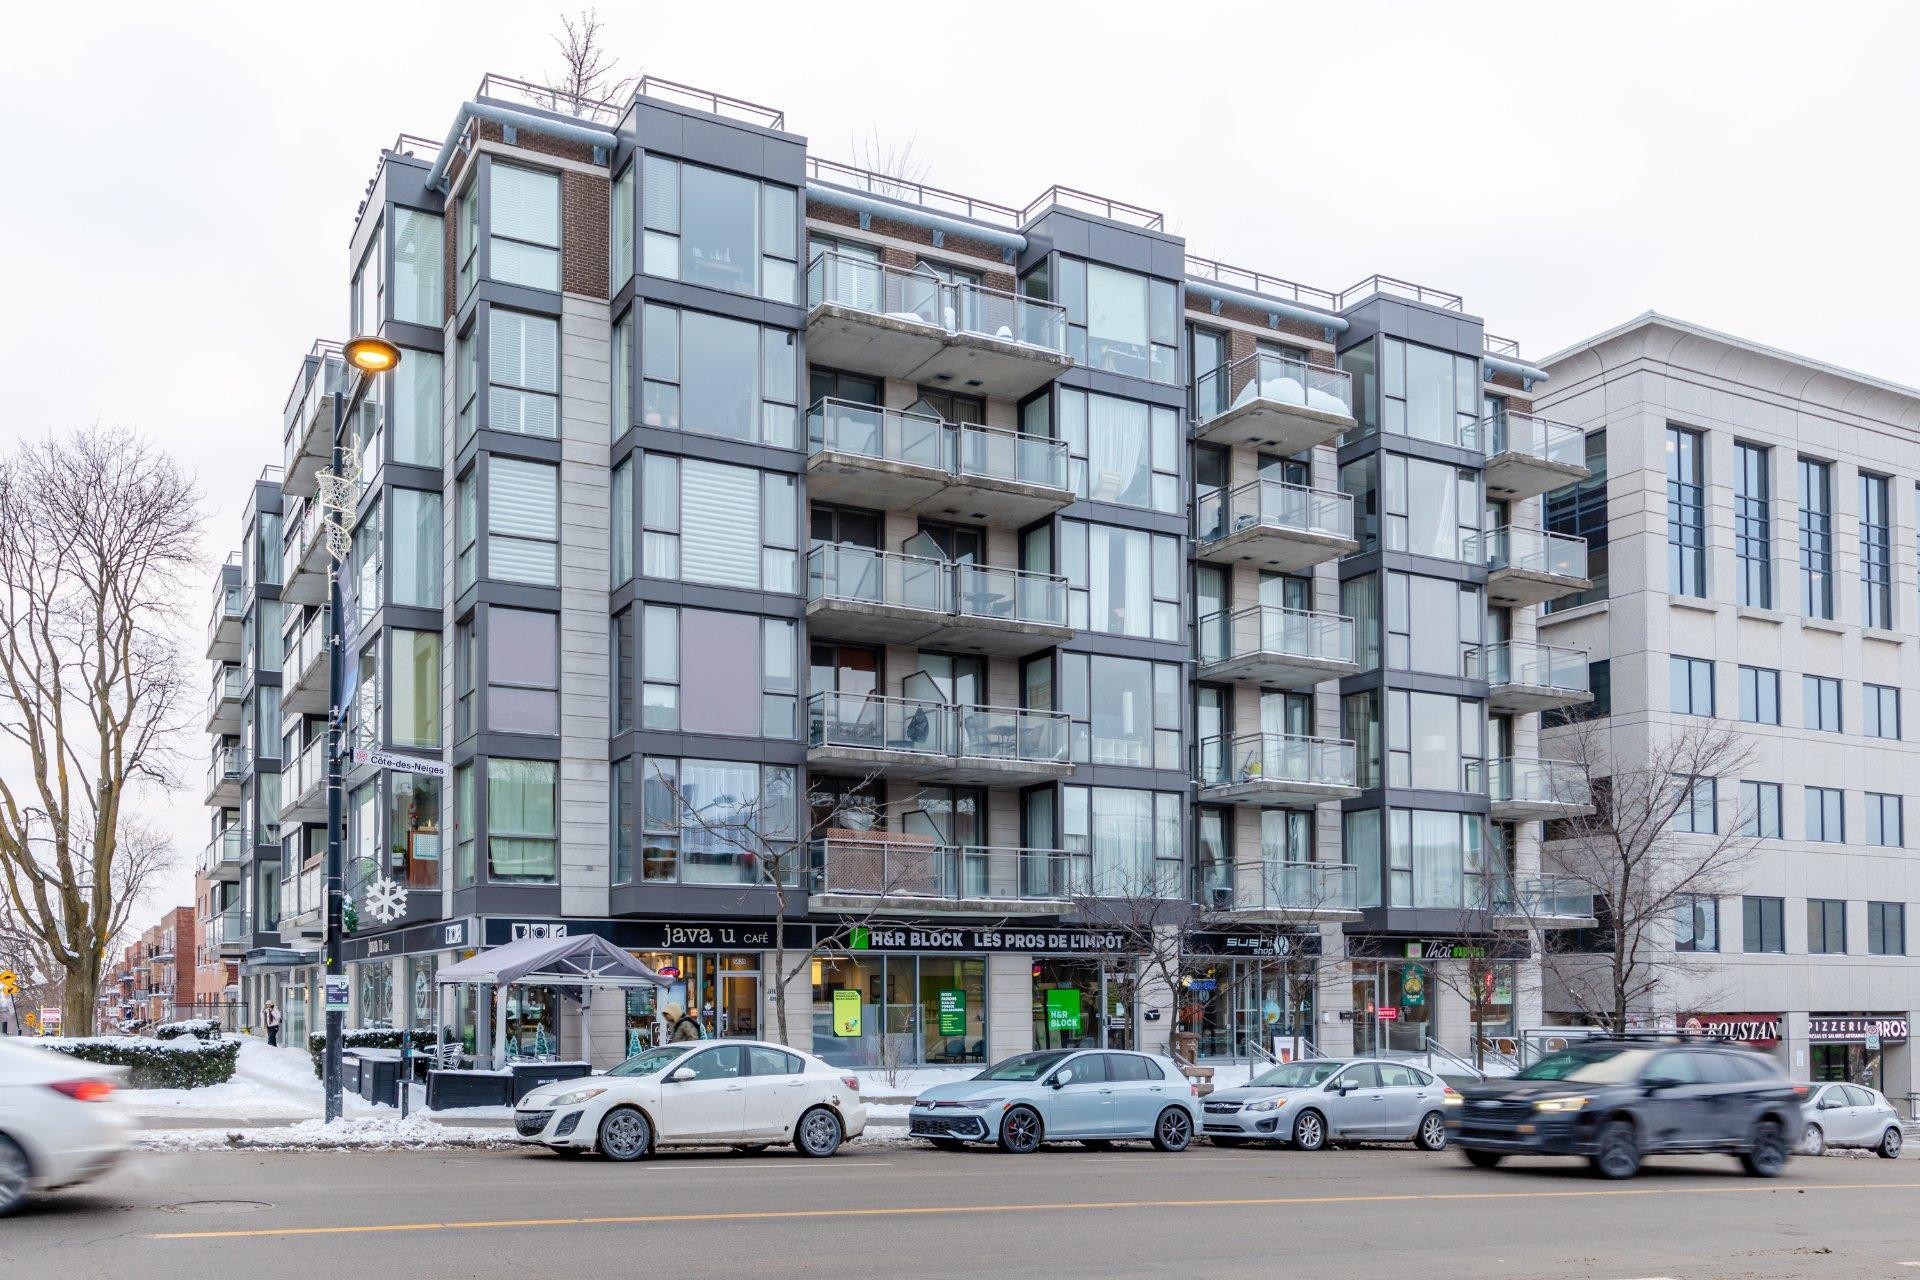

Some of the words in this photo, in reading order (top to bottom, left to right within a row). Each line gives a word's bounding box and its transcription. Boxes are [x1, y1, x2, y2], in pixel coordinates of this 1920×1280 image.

[370, 755, 444, 776] Côte-des-Neiges
[661, 924, 713, 948] java
[718, 928, 736, 943] u
[743, 932, 769, 944] CAFÉ
[871, 932, 906, 946] H&R
[910, 932, 964, 947] BLOCK
[974, 933, 1001, 947] LES
[1005, 933, 1046, 948] PROS
[1049, 934, 1068, 948] DE
[1226, 934, 1273, 947] sushi
[1253, 947, 1274, 955] shop
[1050, 1010, 1068, 1019] H&R
[1050, 1018, 1078, 1027] BLOCK
